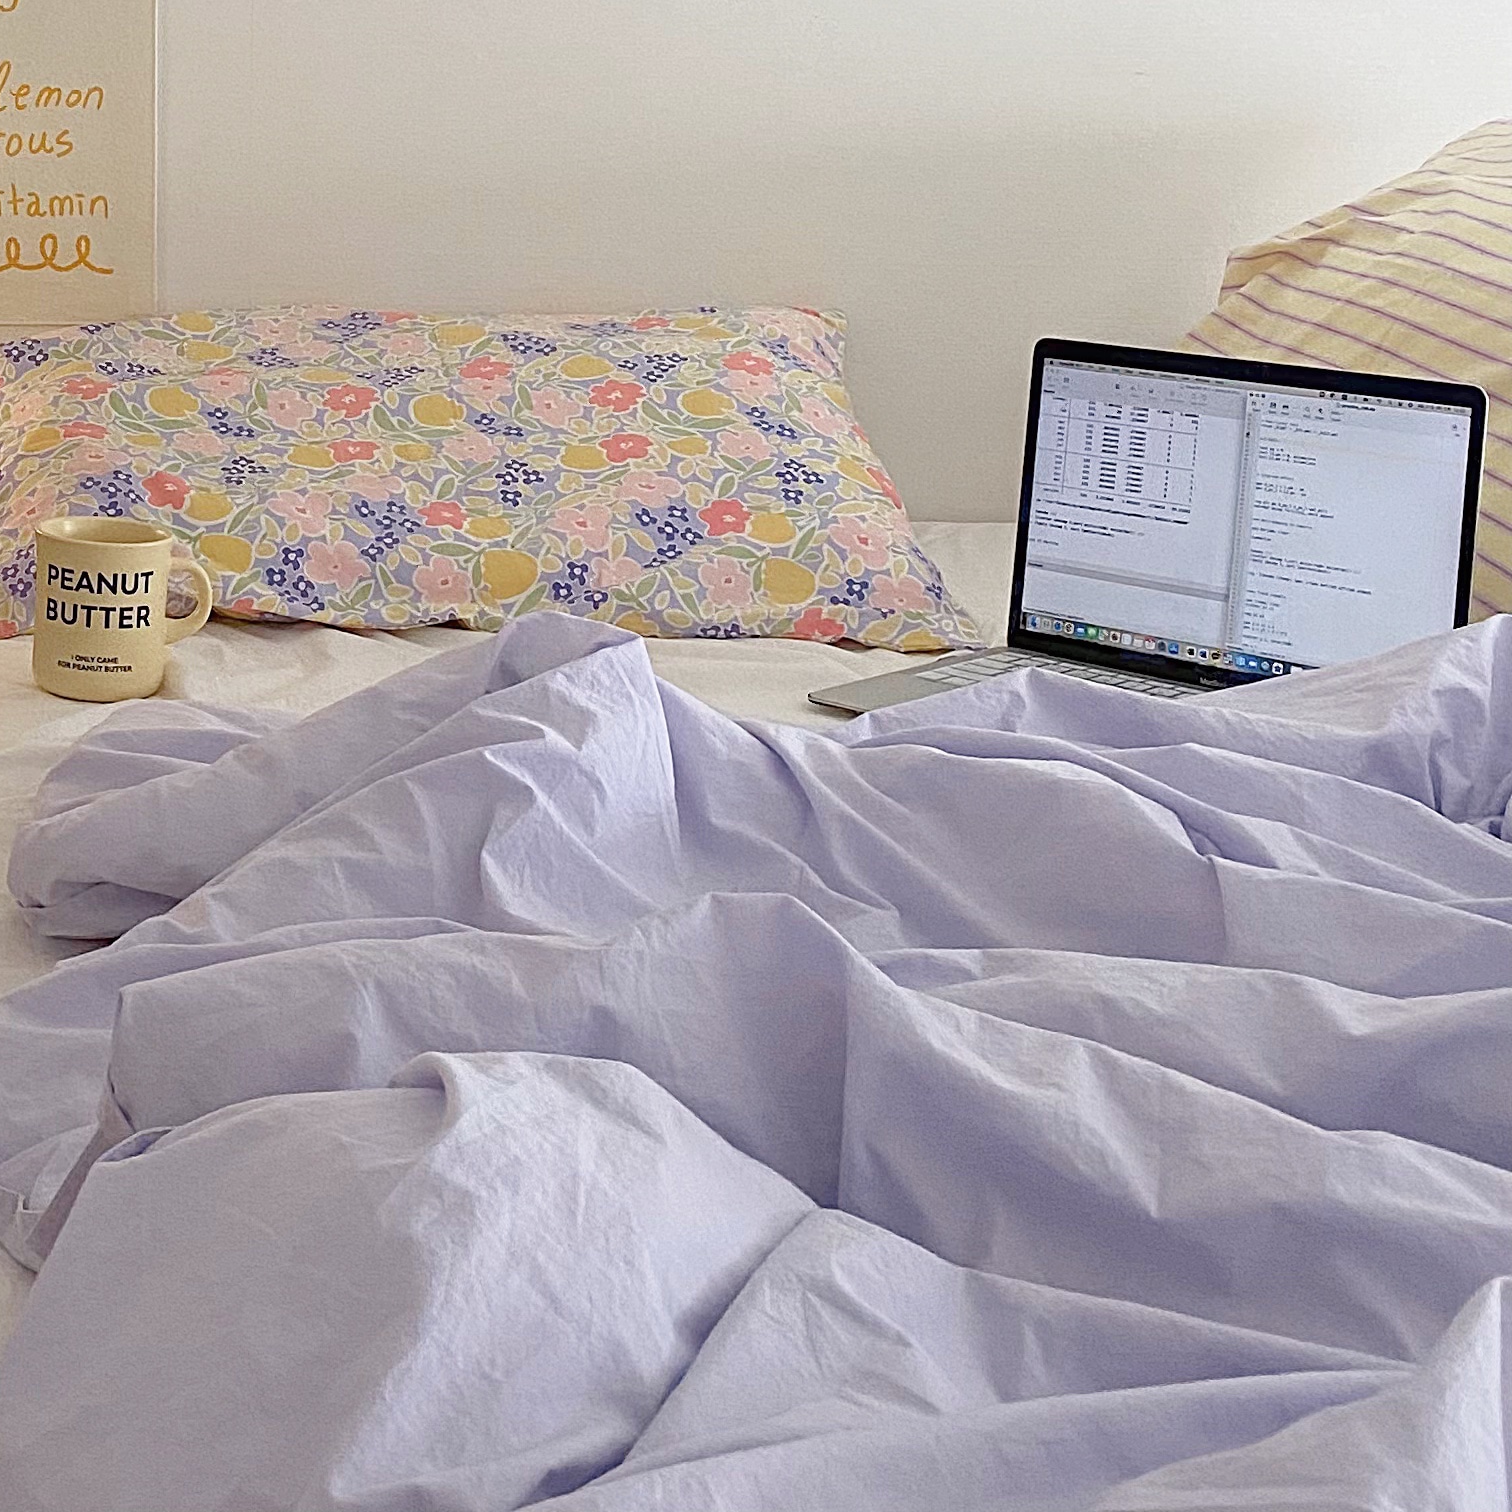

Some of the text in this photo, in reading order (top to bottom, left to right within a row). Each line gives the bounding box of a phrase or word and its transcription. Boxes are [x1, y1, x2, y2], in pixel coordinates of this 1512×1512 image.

[47, 563, 154, 596] PEANUT
[46, 597, 151, 630] BUTTER
[57, 660, 133, 672] FOR PEANUT BUTTER
[75, 654, 96, 663] ONLY
[96, 656, 119, 665] CAME
